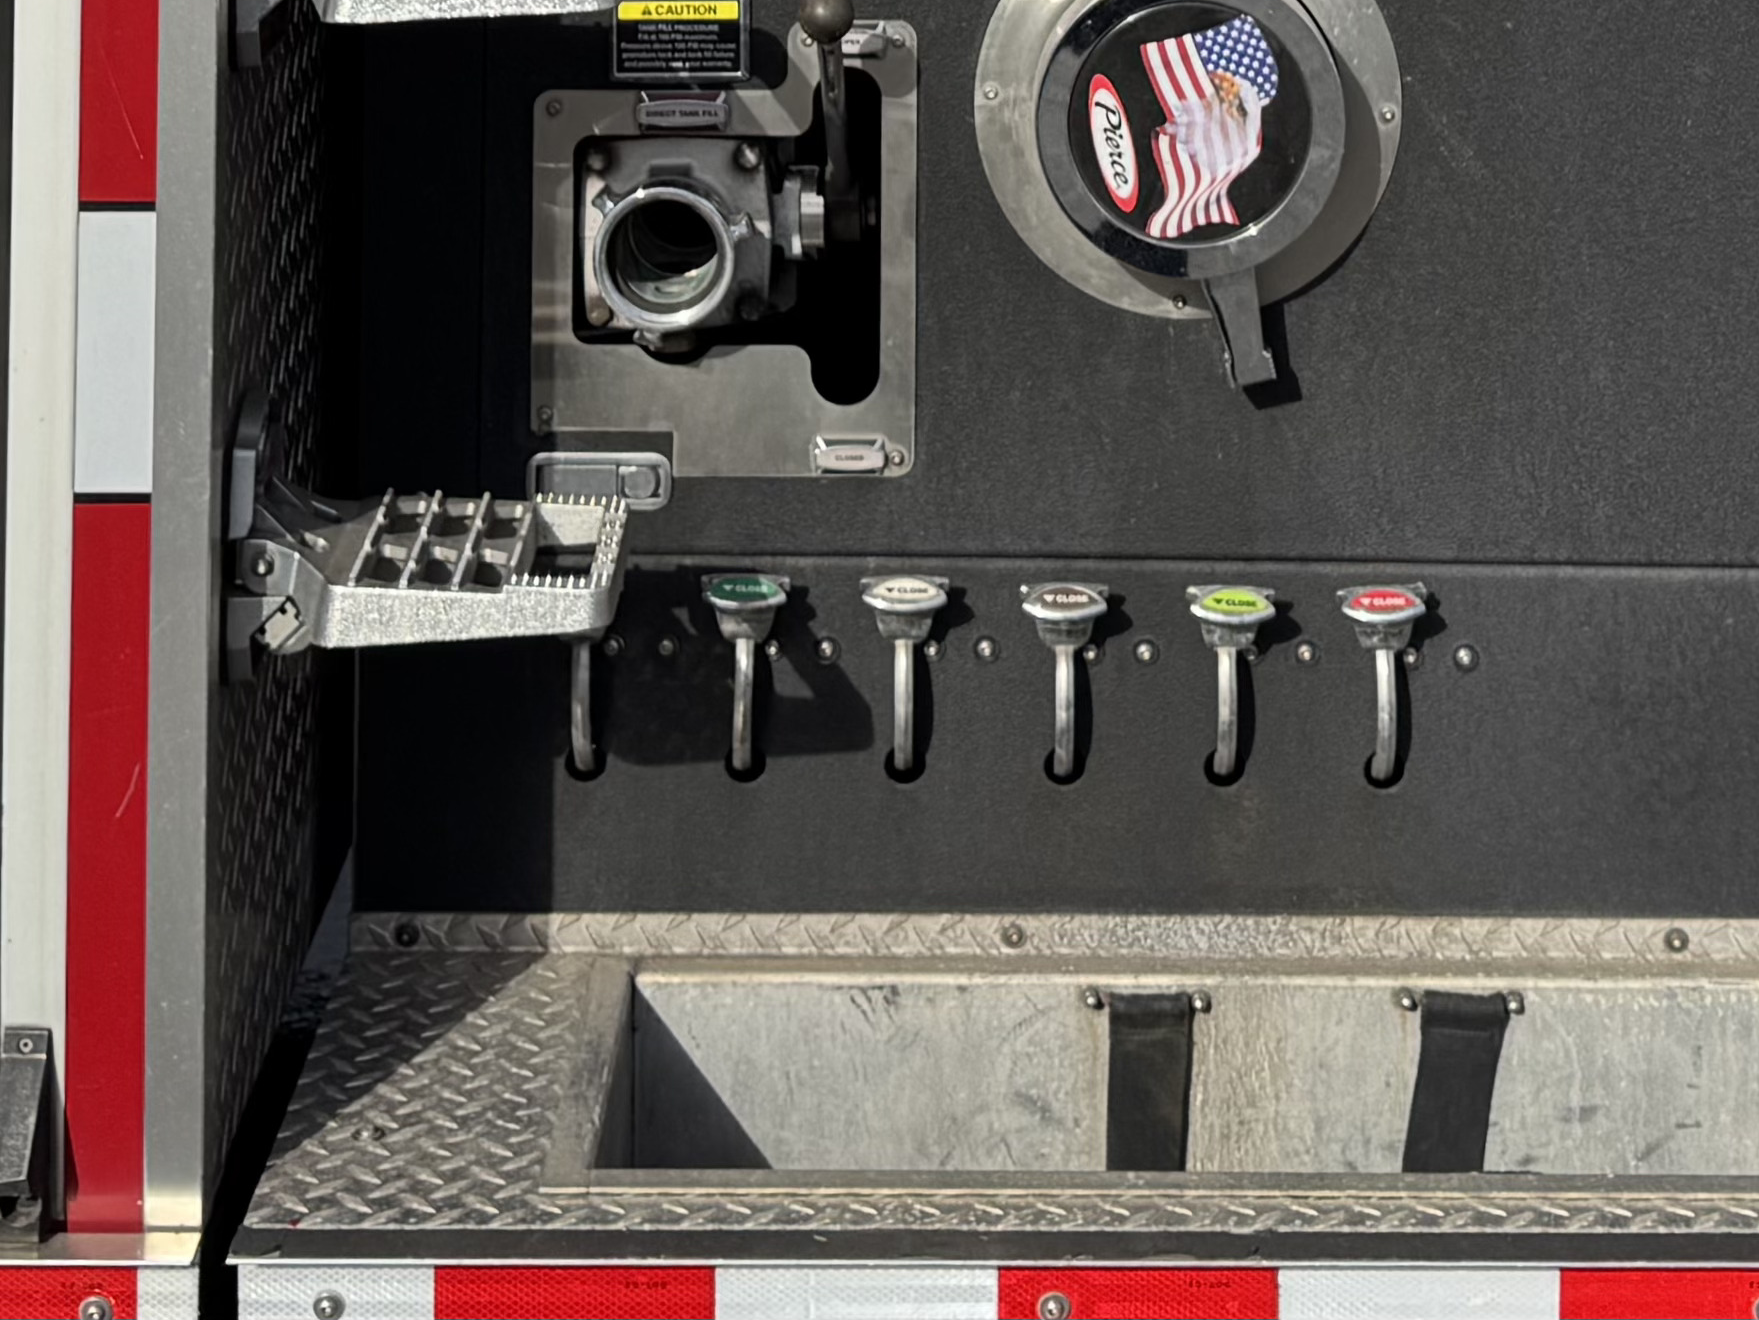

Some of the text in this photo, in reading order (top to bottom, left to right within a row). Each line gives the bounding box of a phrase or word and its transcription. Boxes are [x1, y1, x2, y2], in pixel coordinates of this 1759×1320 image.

[654, 4, 717, 16] CAUTION
[1094, 101, 1129, 190] Pierce
[734, 583, 771, 594] CLOSE
[897, 586, 929, 595] CLOSE
[1055, 593, 1090, 604] CLOSE
[1225, 598, 1259, 609] CLOSE
[1372, 597, 1407, 607] CLOSE
